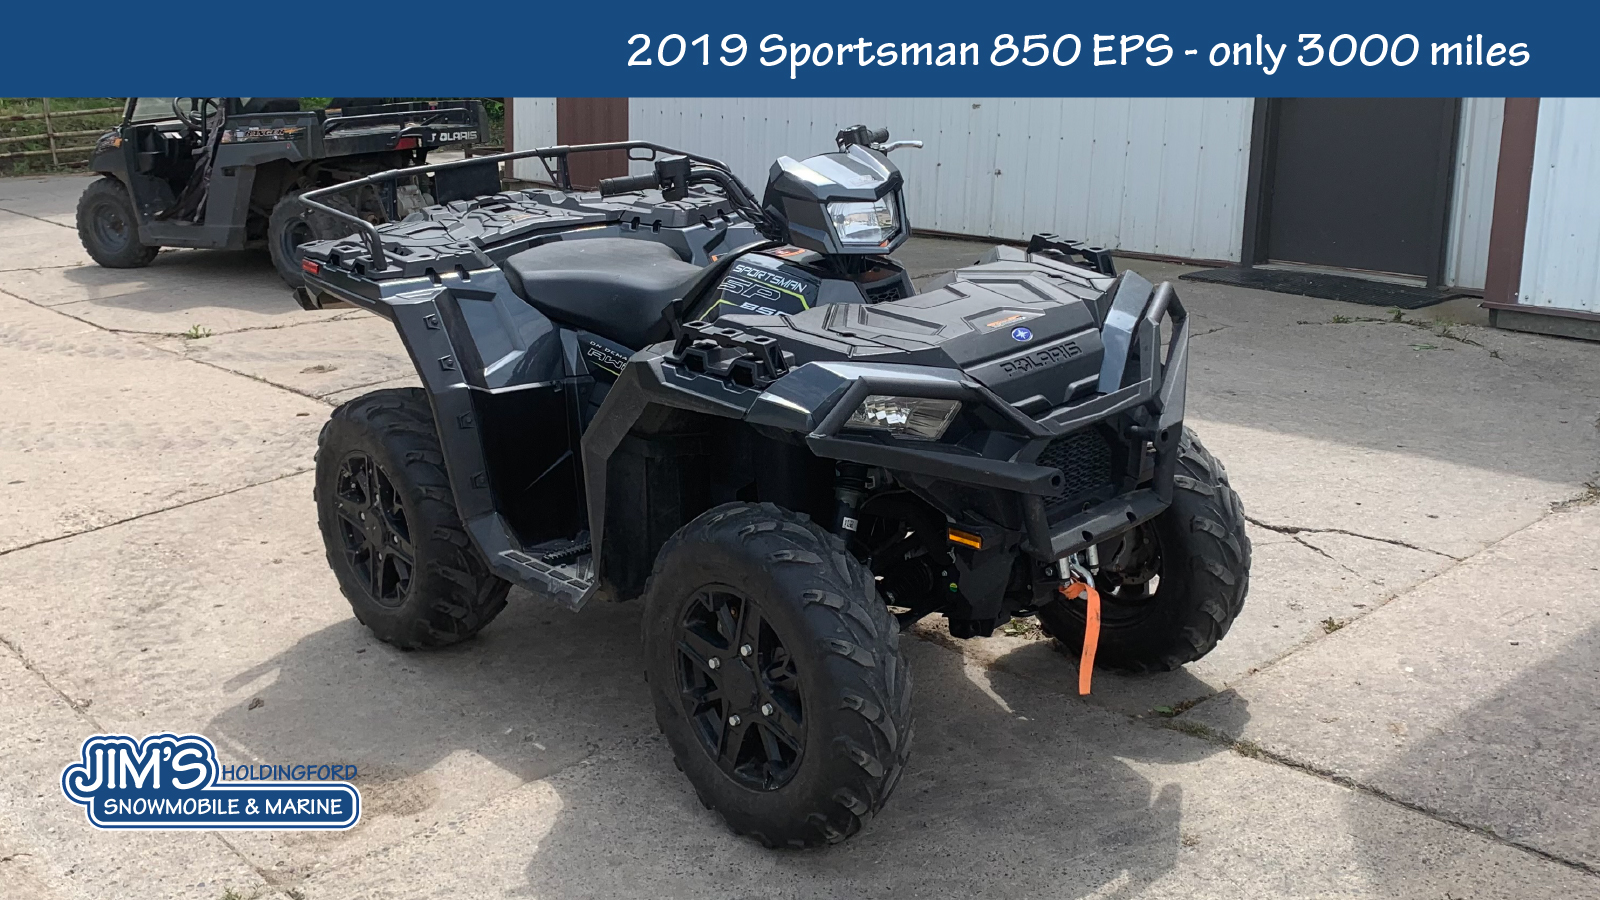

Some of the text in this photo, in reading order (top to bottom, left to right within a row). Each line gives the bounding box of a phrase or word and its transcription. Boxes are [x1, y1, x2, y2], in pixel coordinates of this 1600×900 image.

[717, 275, 781, 301] SP
[733, 264, 808, 293] SPORTSMAN
[589, 341, 628, 361] ON DEMA
[1000, 341, 1083, 377] POLARIS
